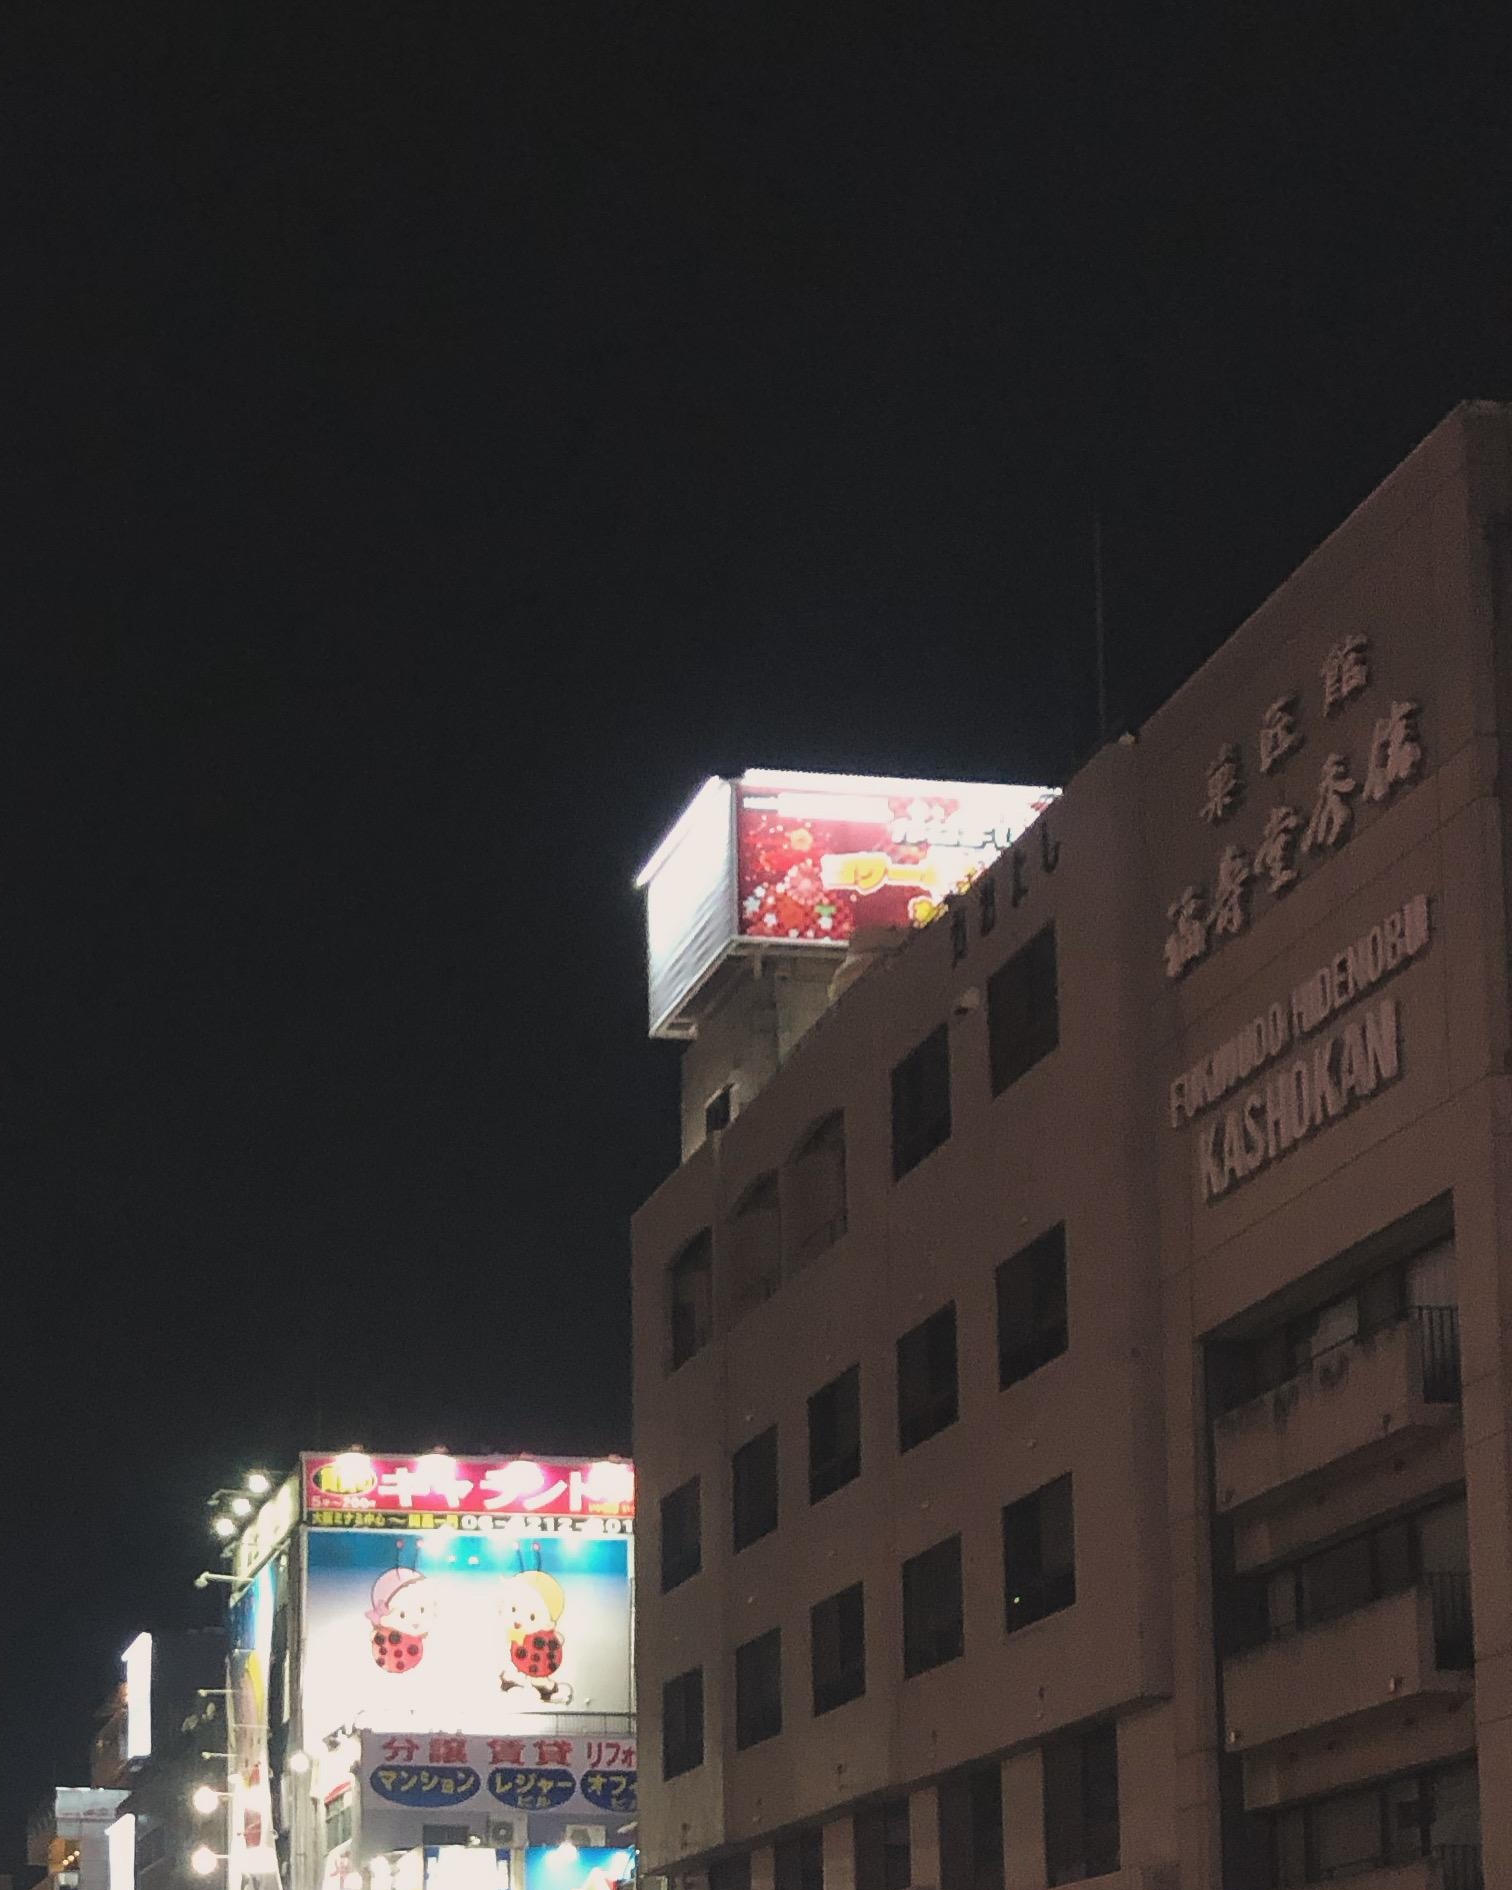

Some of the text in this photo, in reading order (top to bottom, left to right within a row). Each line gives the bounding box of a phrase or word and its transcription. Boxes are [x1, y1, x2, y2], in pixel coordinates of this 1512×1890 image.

[1198, 999, 1399, 1200] KASHOKAN
[377, 1769, 475, 1793] マンション
[495, 1771, 573, 1794] レジャー
